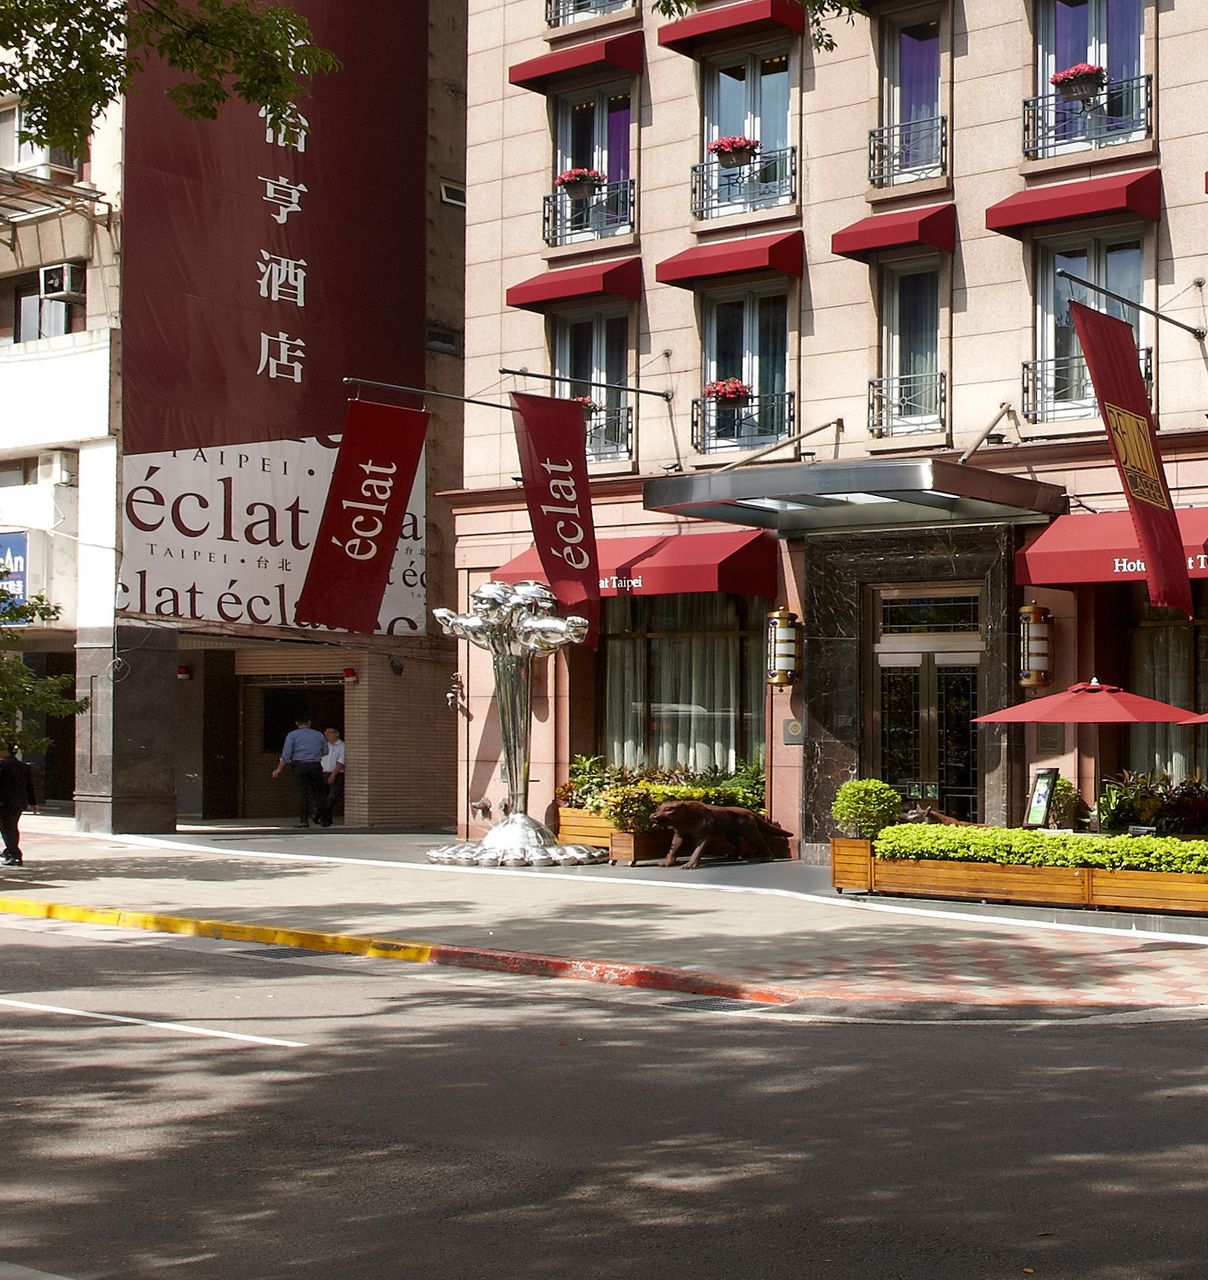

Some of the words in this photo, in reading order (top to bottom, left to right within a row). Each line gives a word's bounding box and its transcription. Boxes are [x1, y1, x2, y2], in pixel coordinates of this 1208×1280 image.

[125, 465, 311, 551] éclat
[331, 459, 397, 560] éclat
[540, 458, 590, 569] éclat
[147, 543, 228, 565] TAIPEI
[256, 556, 292, 572] 台北
[610, 576, 643, 591] Taipei
